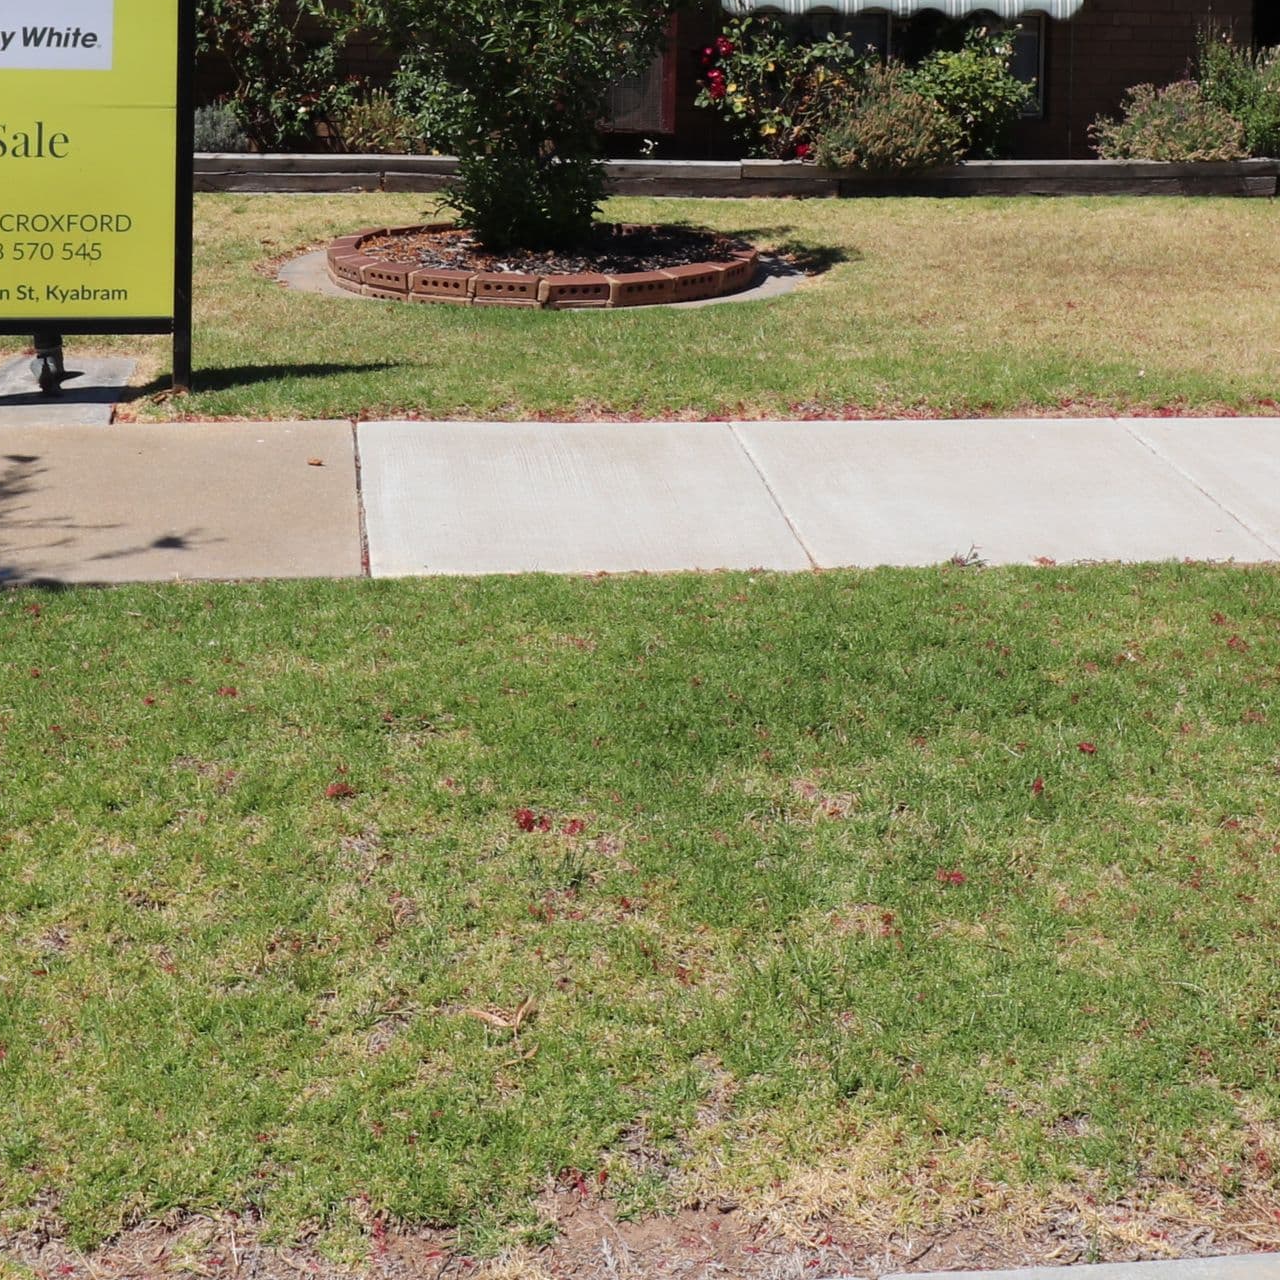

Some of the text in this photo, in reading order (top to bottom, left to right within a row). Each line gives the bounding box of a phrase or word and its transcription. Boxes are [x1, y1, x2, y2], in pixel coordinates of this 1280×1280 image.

[22, 26, 98, 49] White
[12, 242, 54, 261] 570
[60, 242, 102, 261] 545
[16, 284, 39, 303] St,
[45, 284, 128, 306] Kyabram
